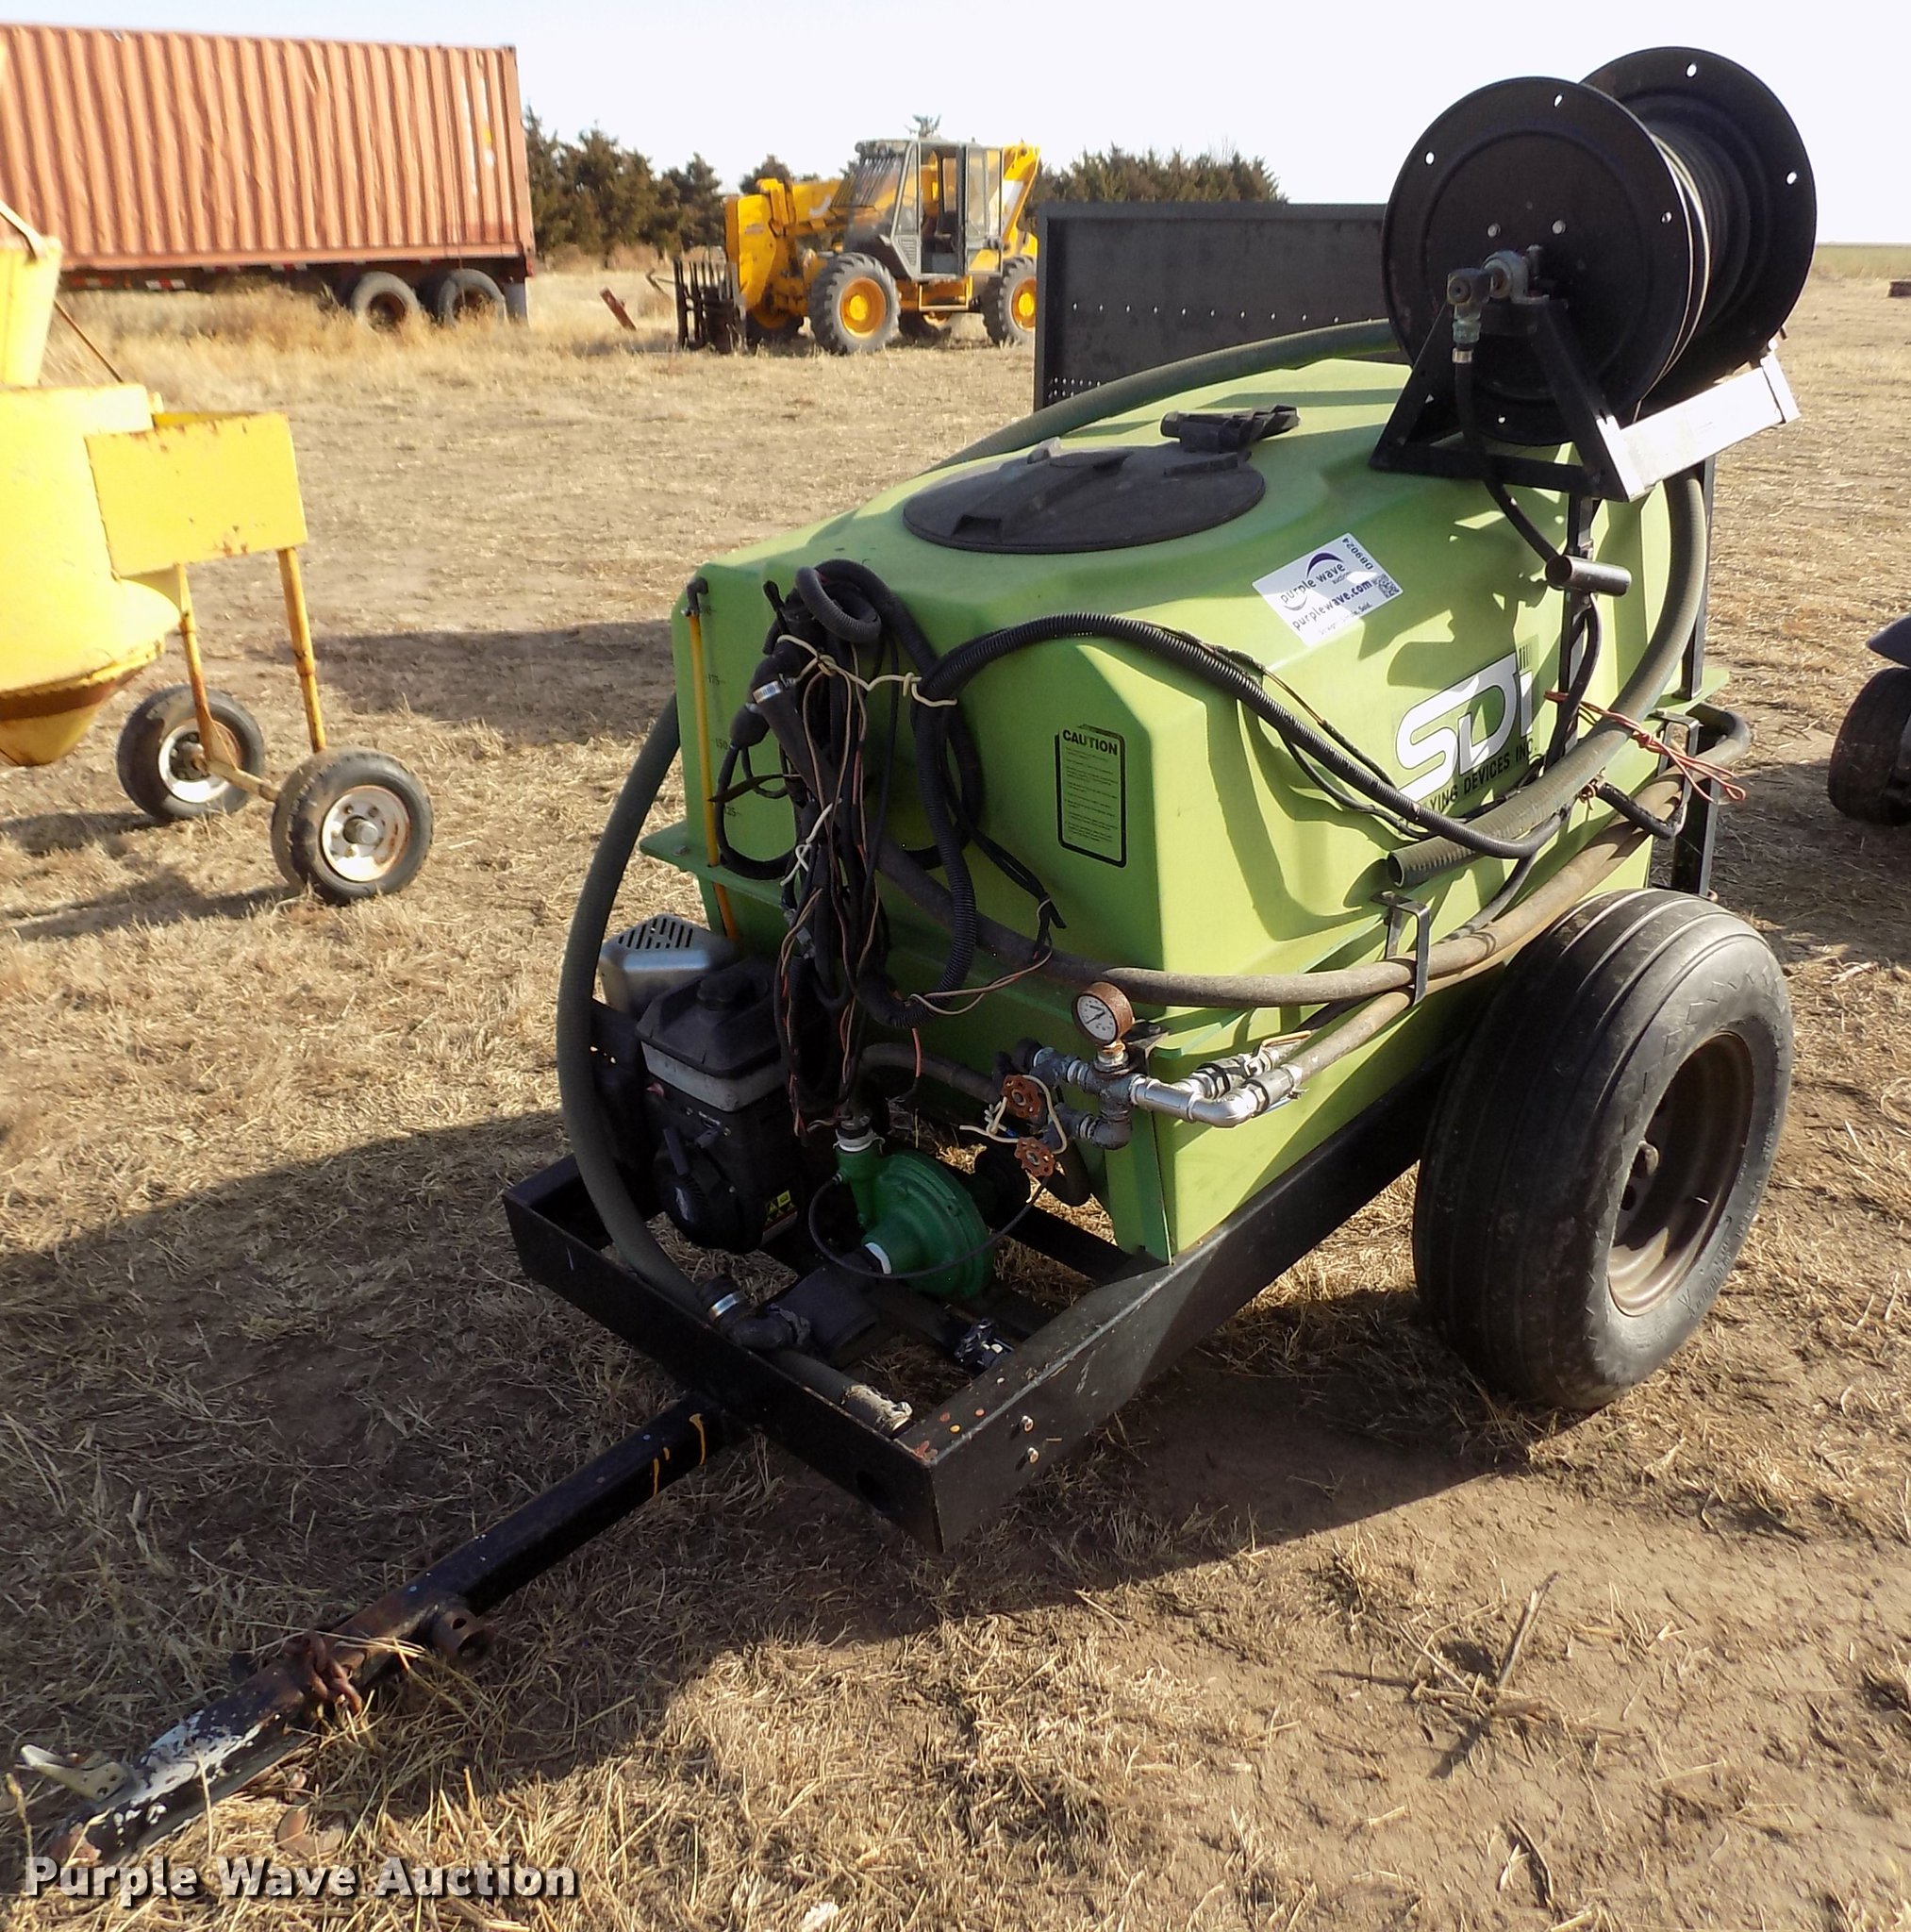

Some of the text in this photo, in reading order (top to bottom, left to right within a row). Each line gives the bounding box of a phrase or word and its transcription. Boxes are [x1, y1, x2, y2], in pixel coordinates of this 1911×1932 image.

[1281, 563, 1345, 603] purple wave
[1292, 579, 1373, 631] purplewave.com
[1062, 729, 1118, 756] CAUTION
[1425, 738, 1537, 813] YING DEVICES INC.
